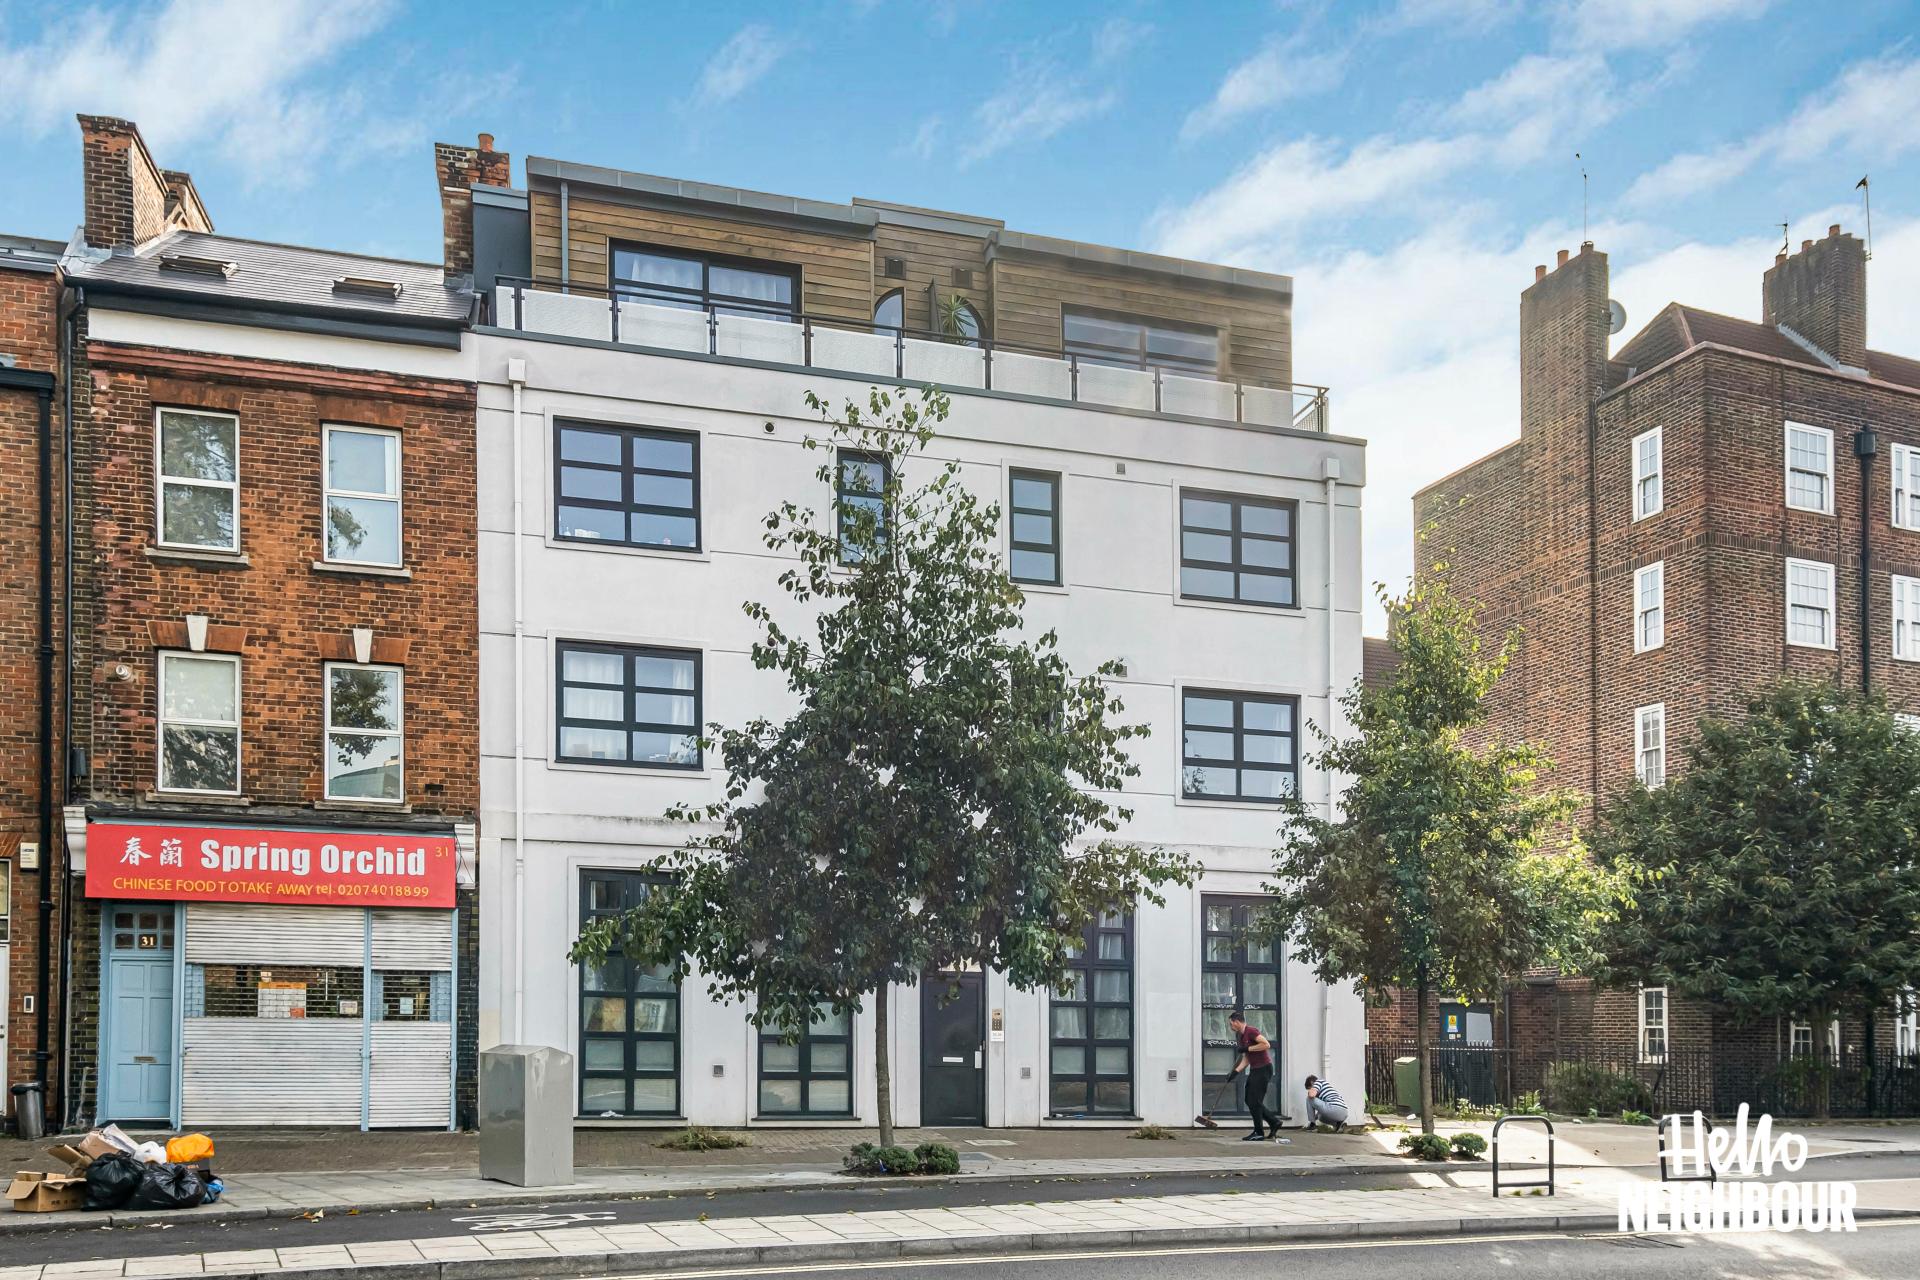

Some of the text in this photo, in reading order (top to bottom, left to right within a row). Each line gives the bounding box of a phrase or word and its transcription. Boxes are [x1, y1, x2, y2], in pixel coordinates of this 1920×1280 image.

[120, 836, 183, 867] 春蘭
[200, 839, 426, 876] Spring Orchid
[435, 846, 449, 858] 31
[113, 877, 172, 891] CHINESE
[176, 879, 216, 892] FOOD
[276, 883, 313, 895] AWAY
[337, 884, 429, 897] 02074018899
[141, 936, 155, 946] 31
